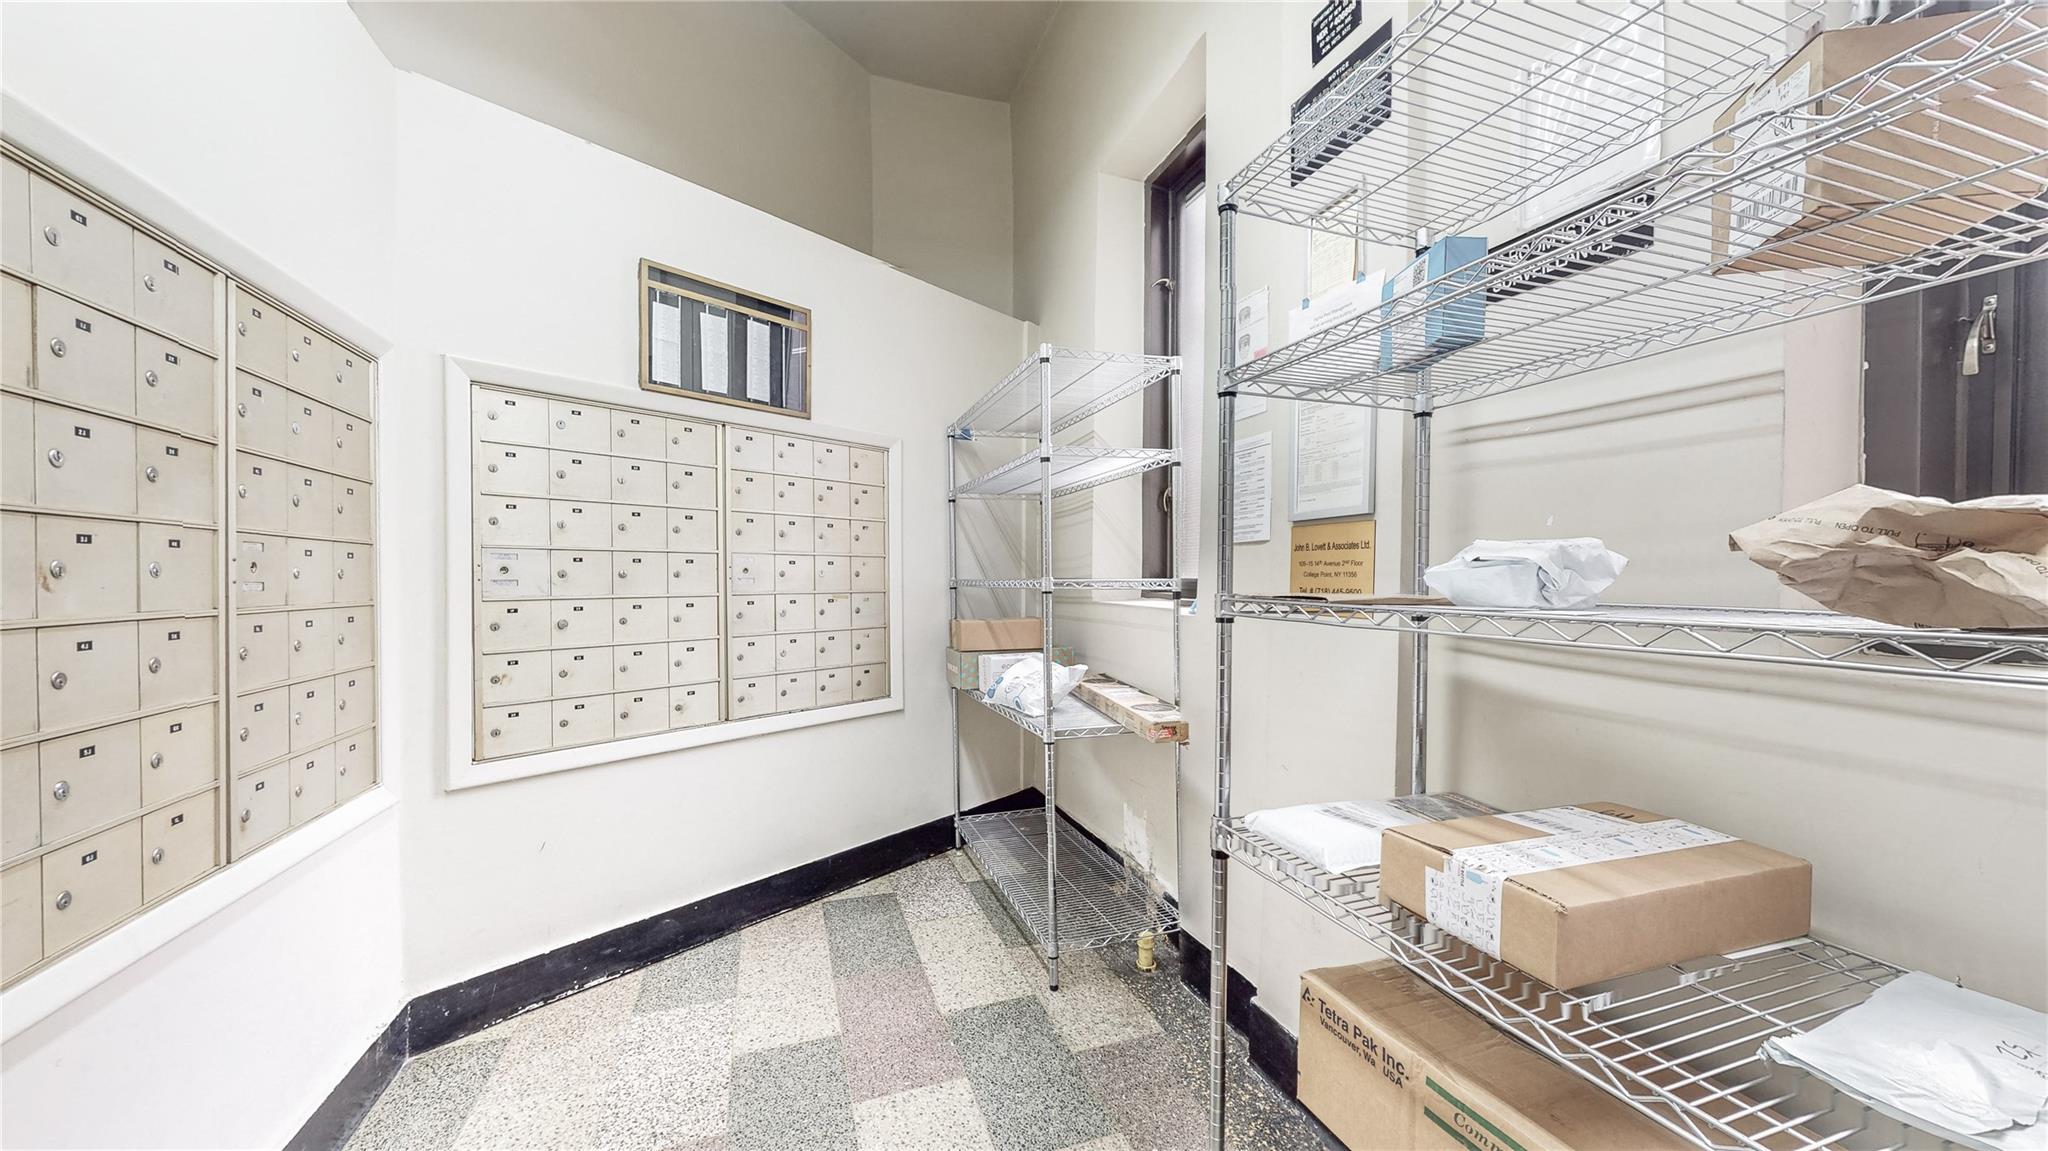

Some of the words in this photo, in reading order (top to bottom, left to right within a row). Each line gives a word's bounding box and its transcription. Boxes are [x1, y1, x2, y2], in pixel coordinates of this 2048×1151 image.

[1328, 61, 1350, 83] NOTICE
[1834, 521, 1859, 532] OPEN
[1861, 526, 1874, 534] TO
[1877, 527, 1902, 538] PULL
[1294, 543, 1305, 552] John
[1311, 542, 1327, 552] Lovett
[1332, 540, 1360, 551] Associates
[1360, 539, 1371, 549] Ltd.
[1303, 571, 1319, 579] College
[1318, 998, 1349, 1034] Tetra
[1353, 1025, 1378, 1056] Pak
[1382, 1047, 1410, 1081] Inc.
[1320, 1016, 1362, 1057] Vancouver,
[1362, 1049, 1376, 1067] Wa
[1382, 1066, 1403, 1088] USA
